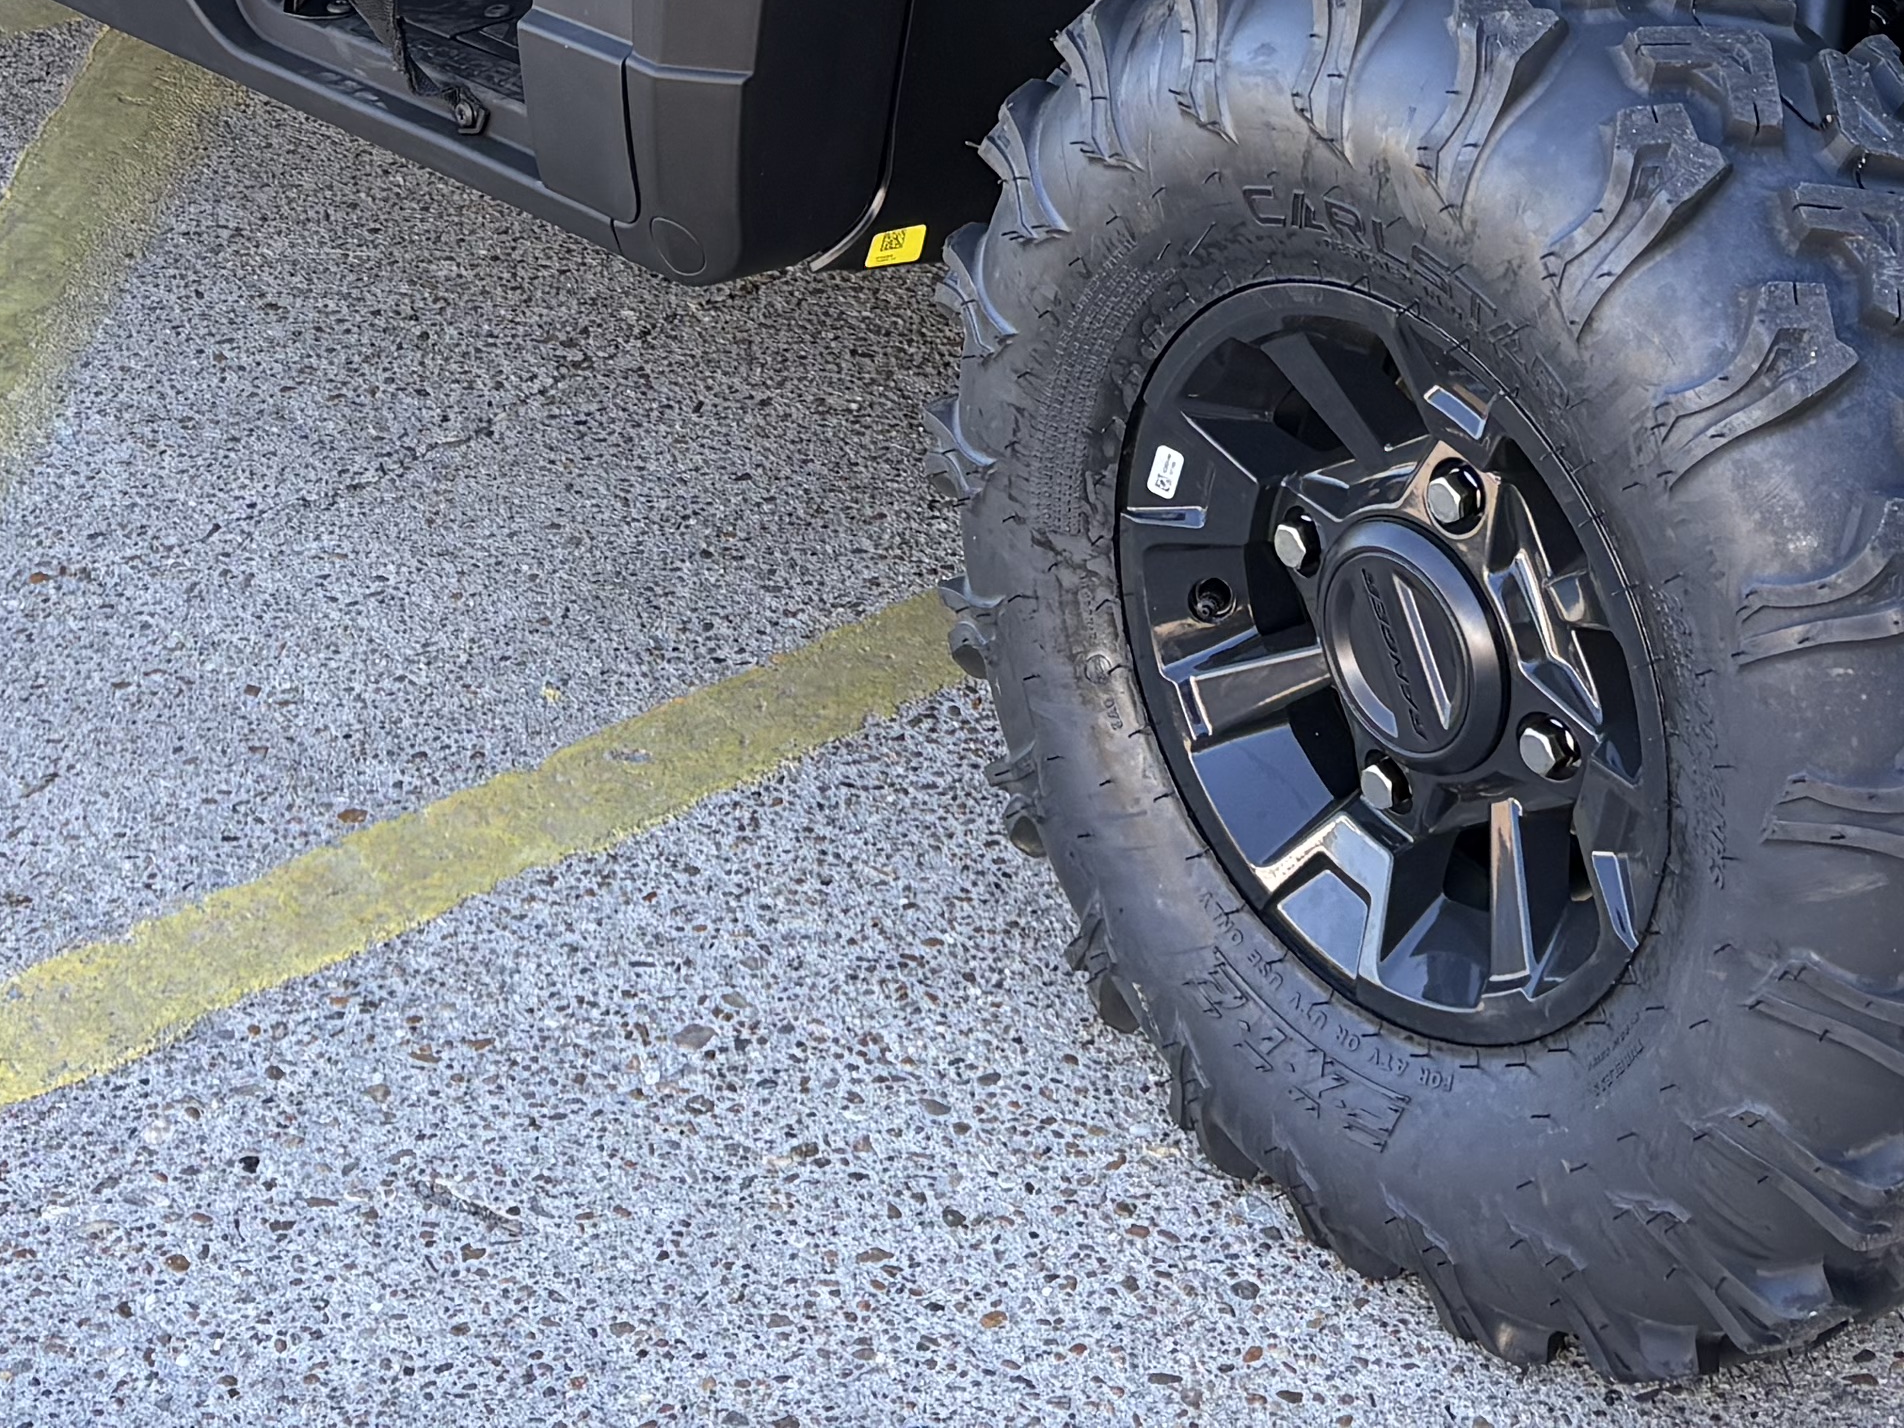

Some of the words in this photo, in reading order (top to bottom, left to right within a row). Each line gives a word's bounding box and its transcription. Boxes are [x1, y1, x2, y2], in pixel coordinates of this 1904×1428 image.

[1361, 567, 1429, 742] RANGER
[1199, 892, 1245, 945] ONLY
[1247, 949, 1284, 991] USE
[1288, 991, 1328, 1030] UTV
[1335, 1024, 1362, 1051] OR
[1367, 1048, 1409, 1074] ATV
[1421, 1069, 1455, 1093] FOR
